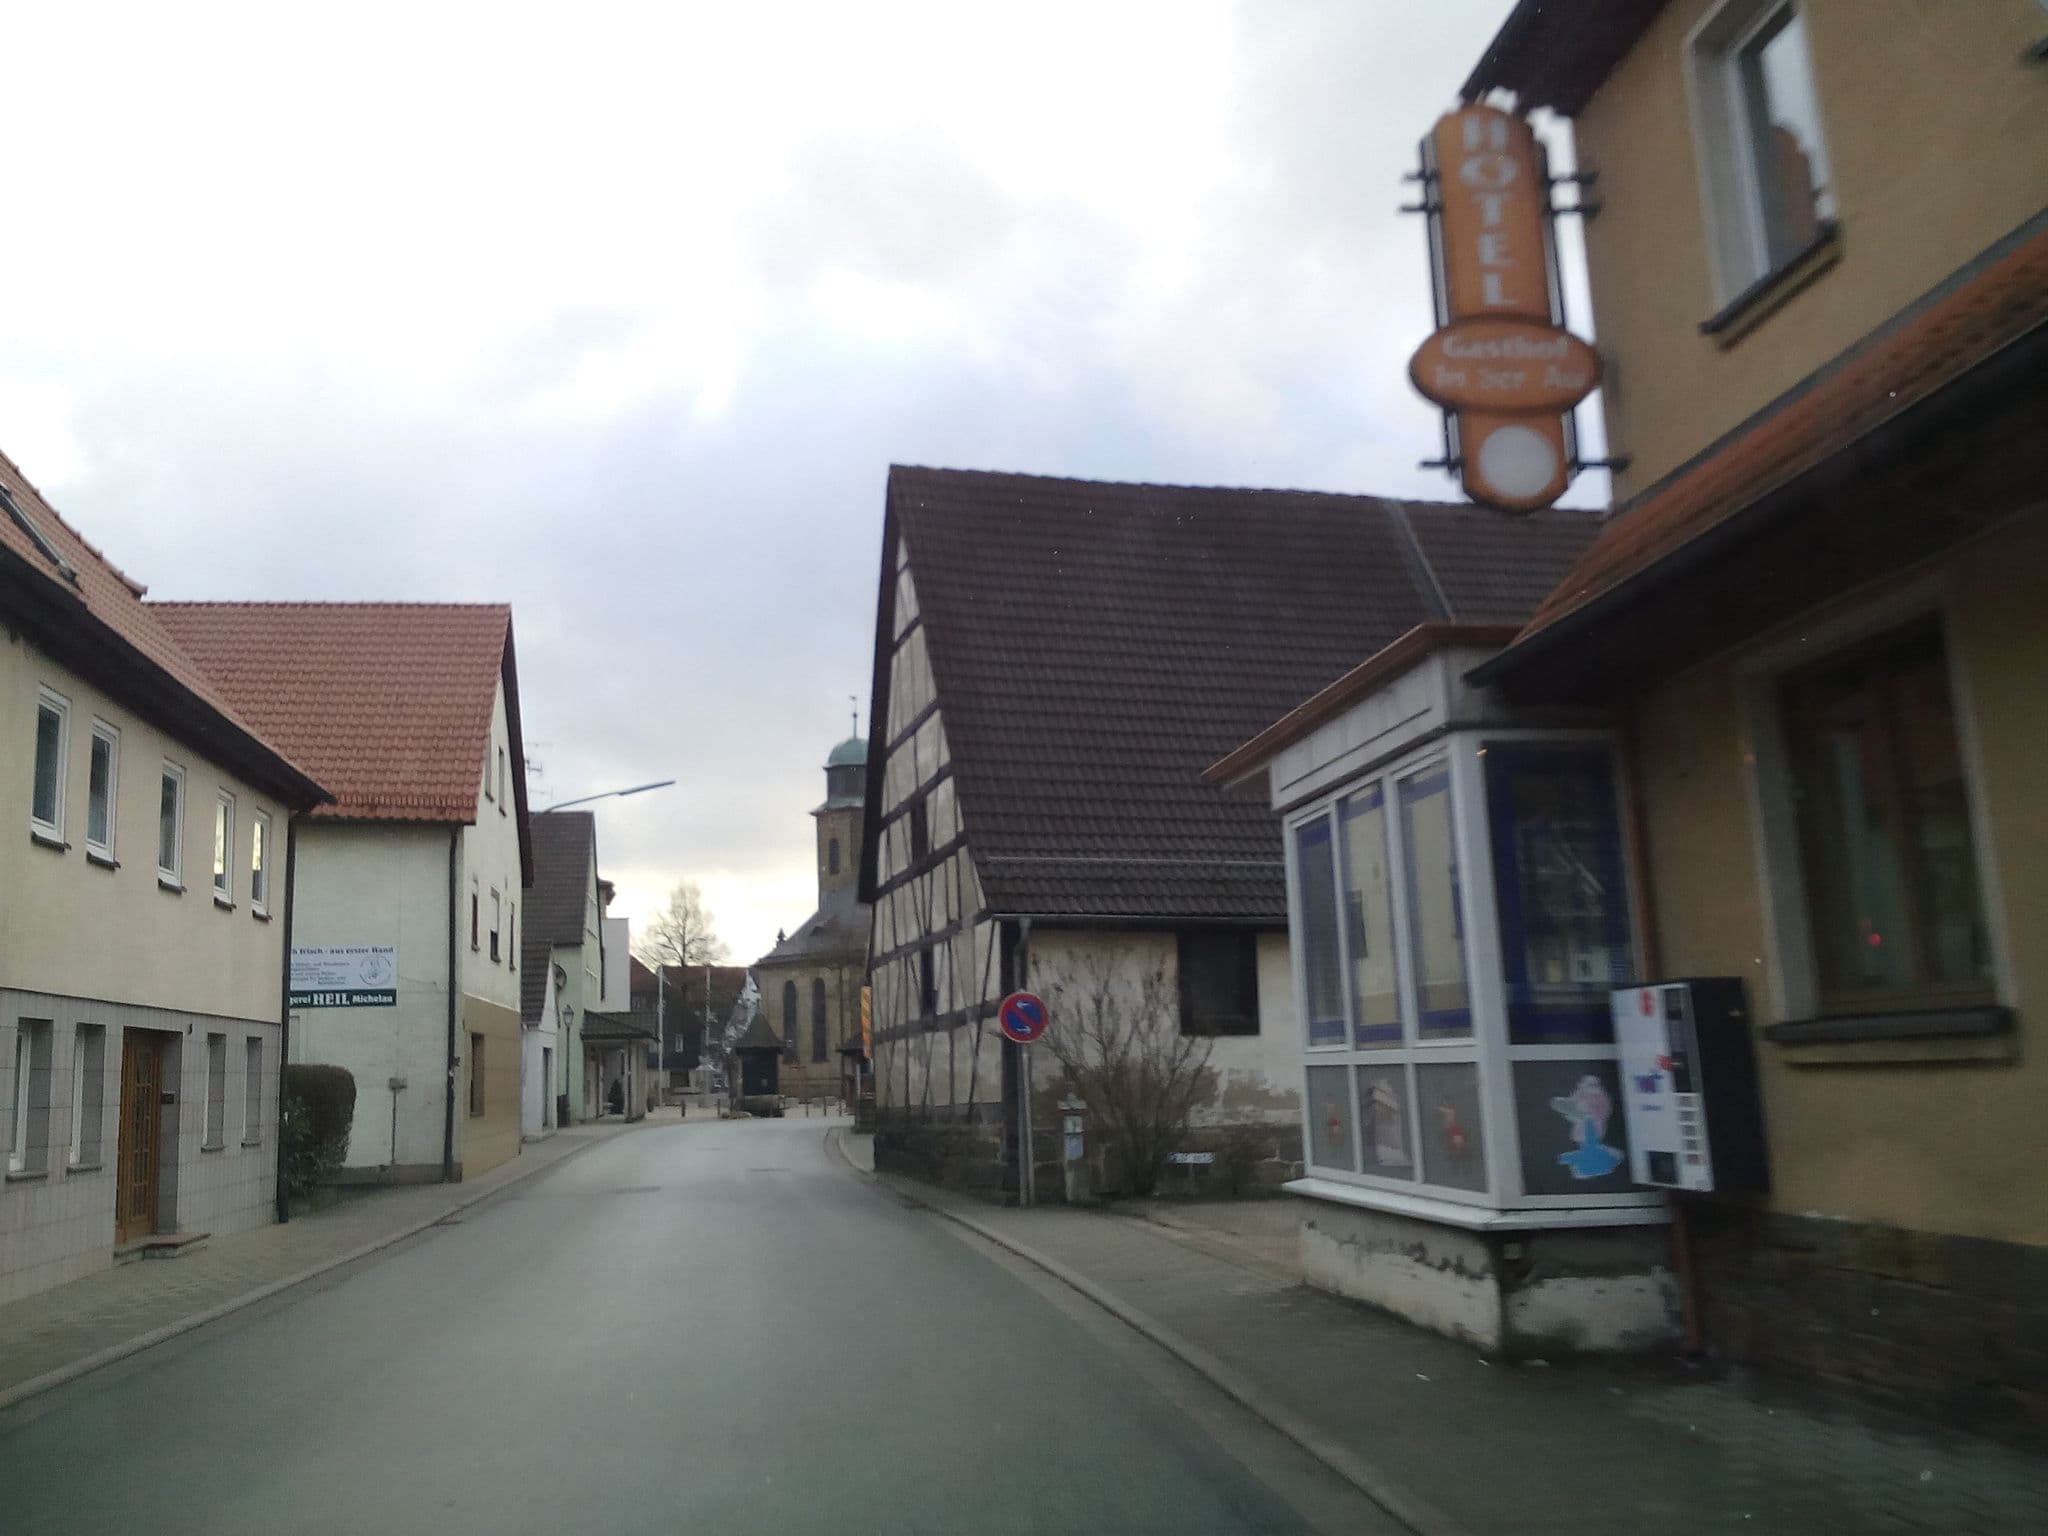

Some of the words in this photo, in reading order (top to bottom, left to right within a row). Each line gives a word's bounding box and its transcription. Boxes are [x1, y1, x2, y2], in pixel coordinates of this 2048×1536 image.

[1460, 115, 1519, 307] HOTEL
[1443, 335, 1568, 358] Gasthof
[299, 947, 324, 955] frisch
[371, 946, 394, 954] Hand
[312, 993, 350, 1006] HEIL
